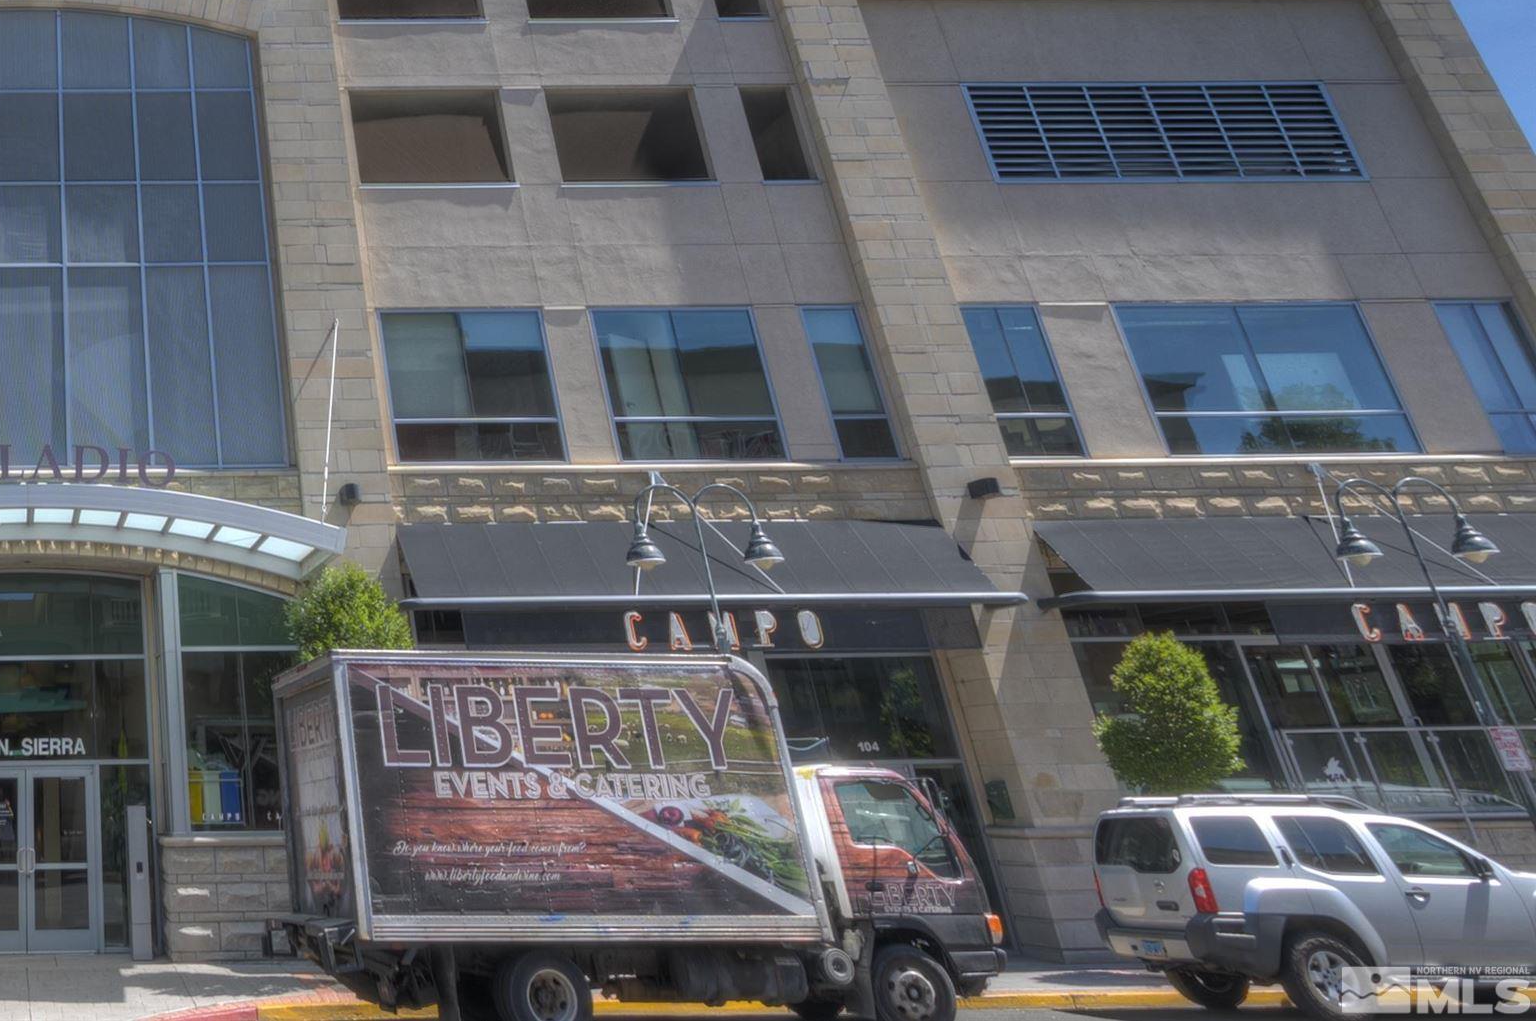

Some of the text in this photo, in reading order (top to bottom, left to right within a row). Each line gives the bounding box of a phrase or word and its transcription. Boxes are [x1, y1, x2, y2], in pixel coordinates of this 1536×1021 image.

[623, 610, 825, 652] CAMPO
[375, 683, 735, 770] LIBERTY
[21, 737, 86, 757] SIERRA
[857, 740, 880, 753] 104
[433, 770, 540, 800] EVENTS
[575, 771, 712, 801] CATERING
